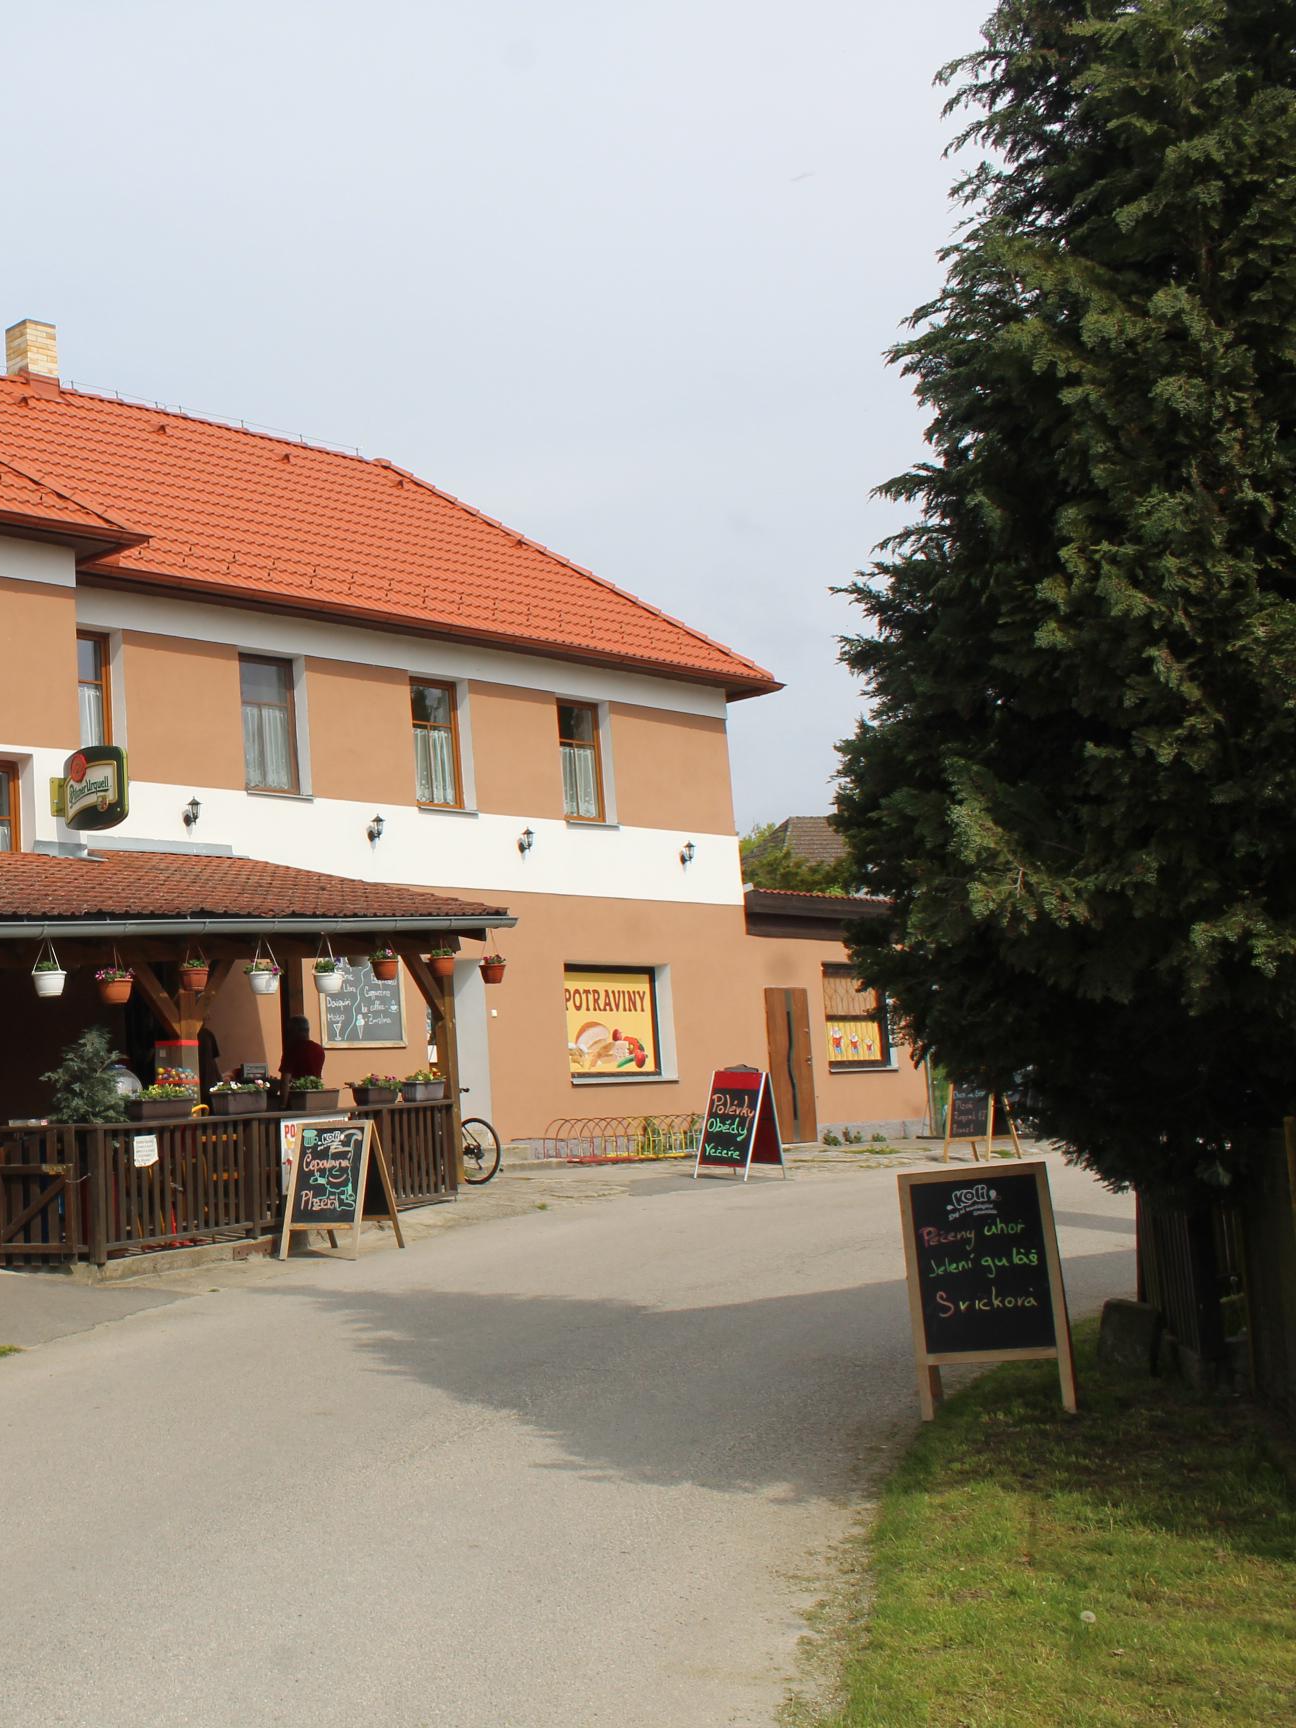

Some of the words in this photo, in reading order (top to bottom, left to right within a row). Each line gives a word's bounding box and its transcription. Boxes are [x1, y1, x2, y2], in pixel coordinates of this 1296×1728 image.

[86, 776, 109, 795] Urquell
[564, 988, 646, 1012] POTRAVINY
[712, 1094, 755, 1122] Polévky
[707, 1117, 747, 1141] Obědy
[929, 1253, 975, 1277] Jelení
